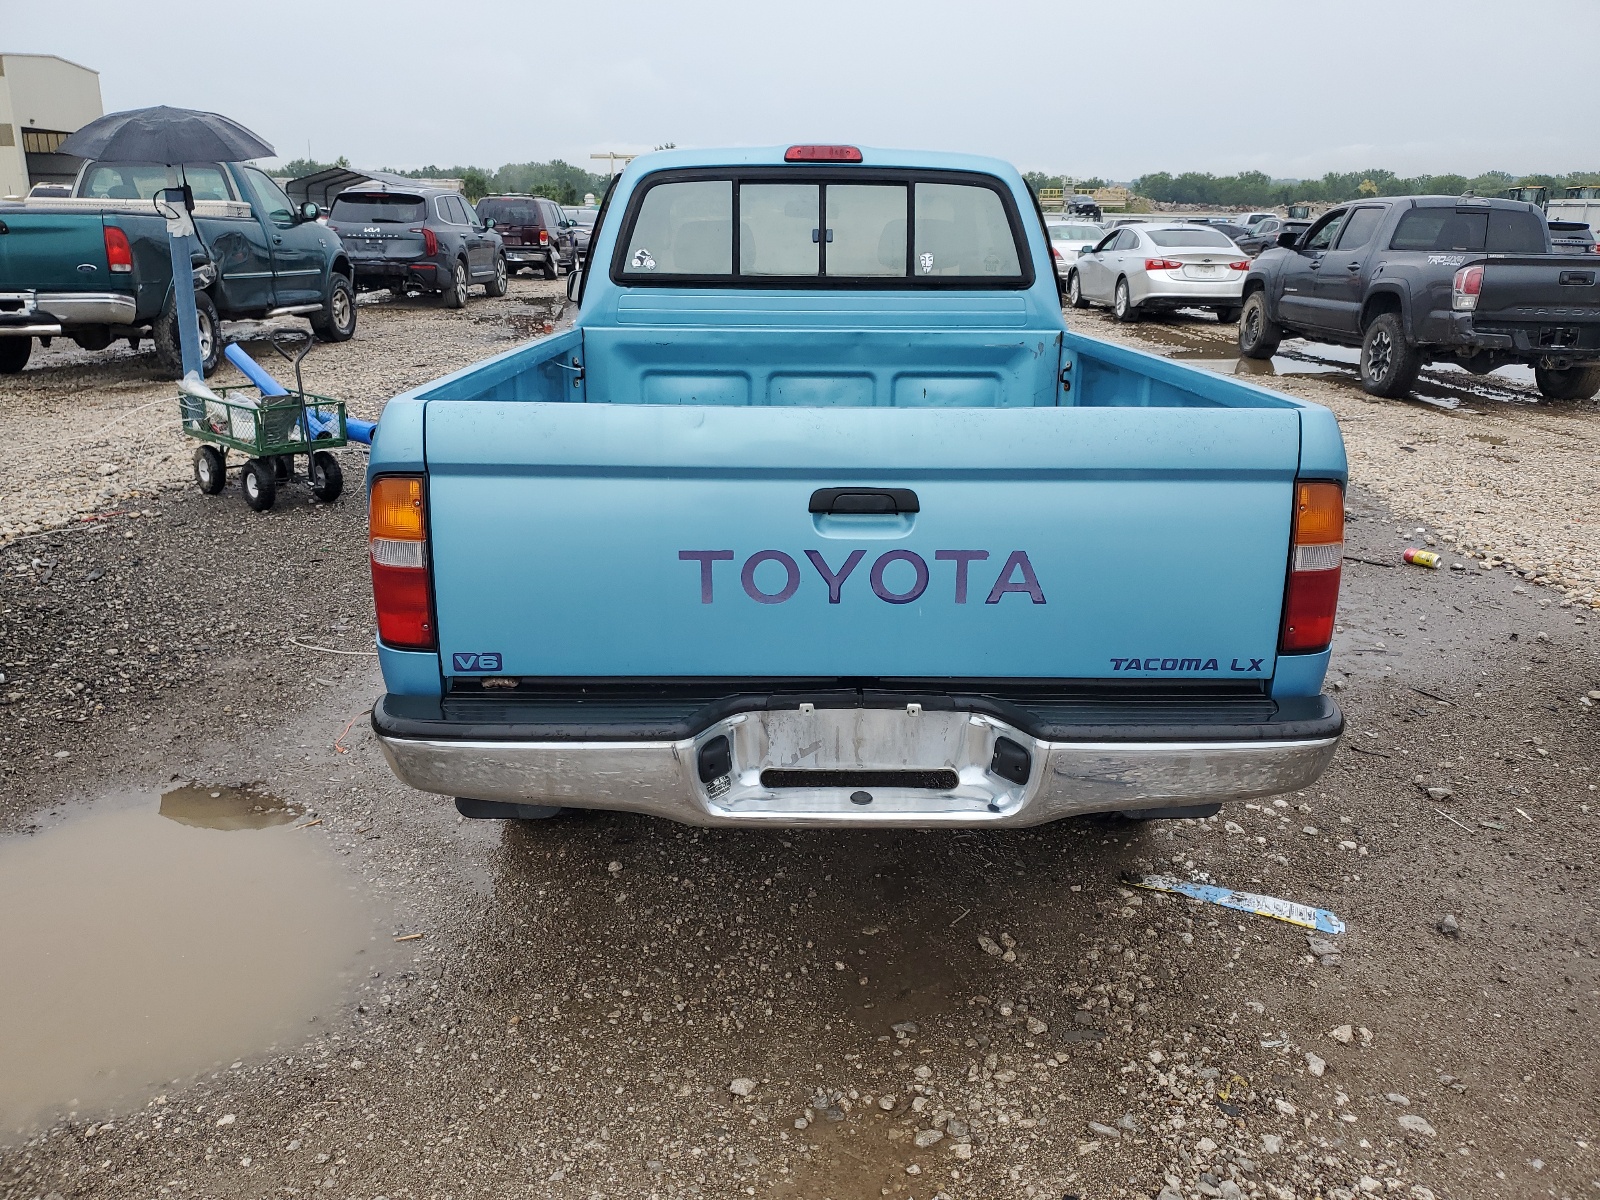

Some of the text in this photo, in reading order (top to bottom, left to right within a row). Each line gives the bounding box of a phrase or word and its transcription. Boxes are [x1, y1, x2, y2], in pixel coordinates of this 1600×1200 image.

[678, 549, 1047, 605] TOYOTA
[454, 655, 499, 670] V6
[1110, 658, 1266, 672] TACOMA LX
